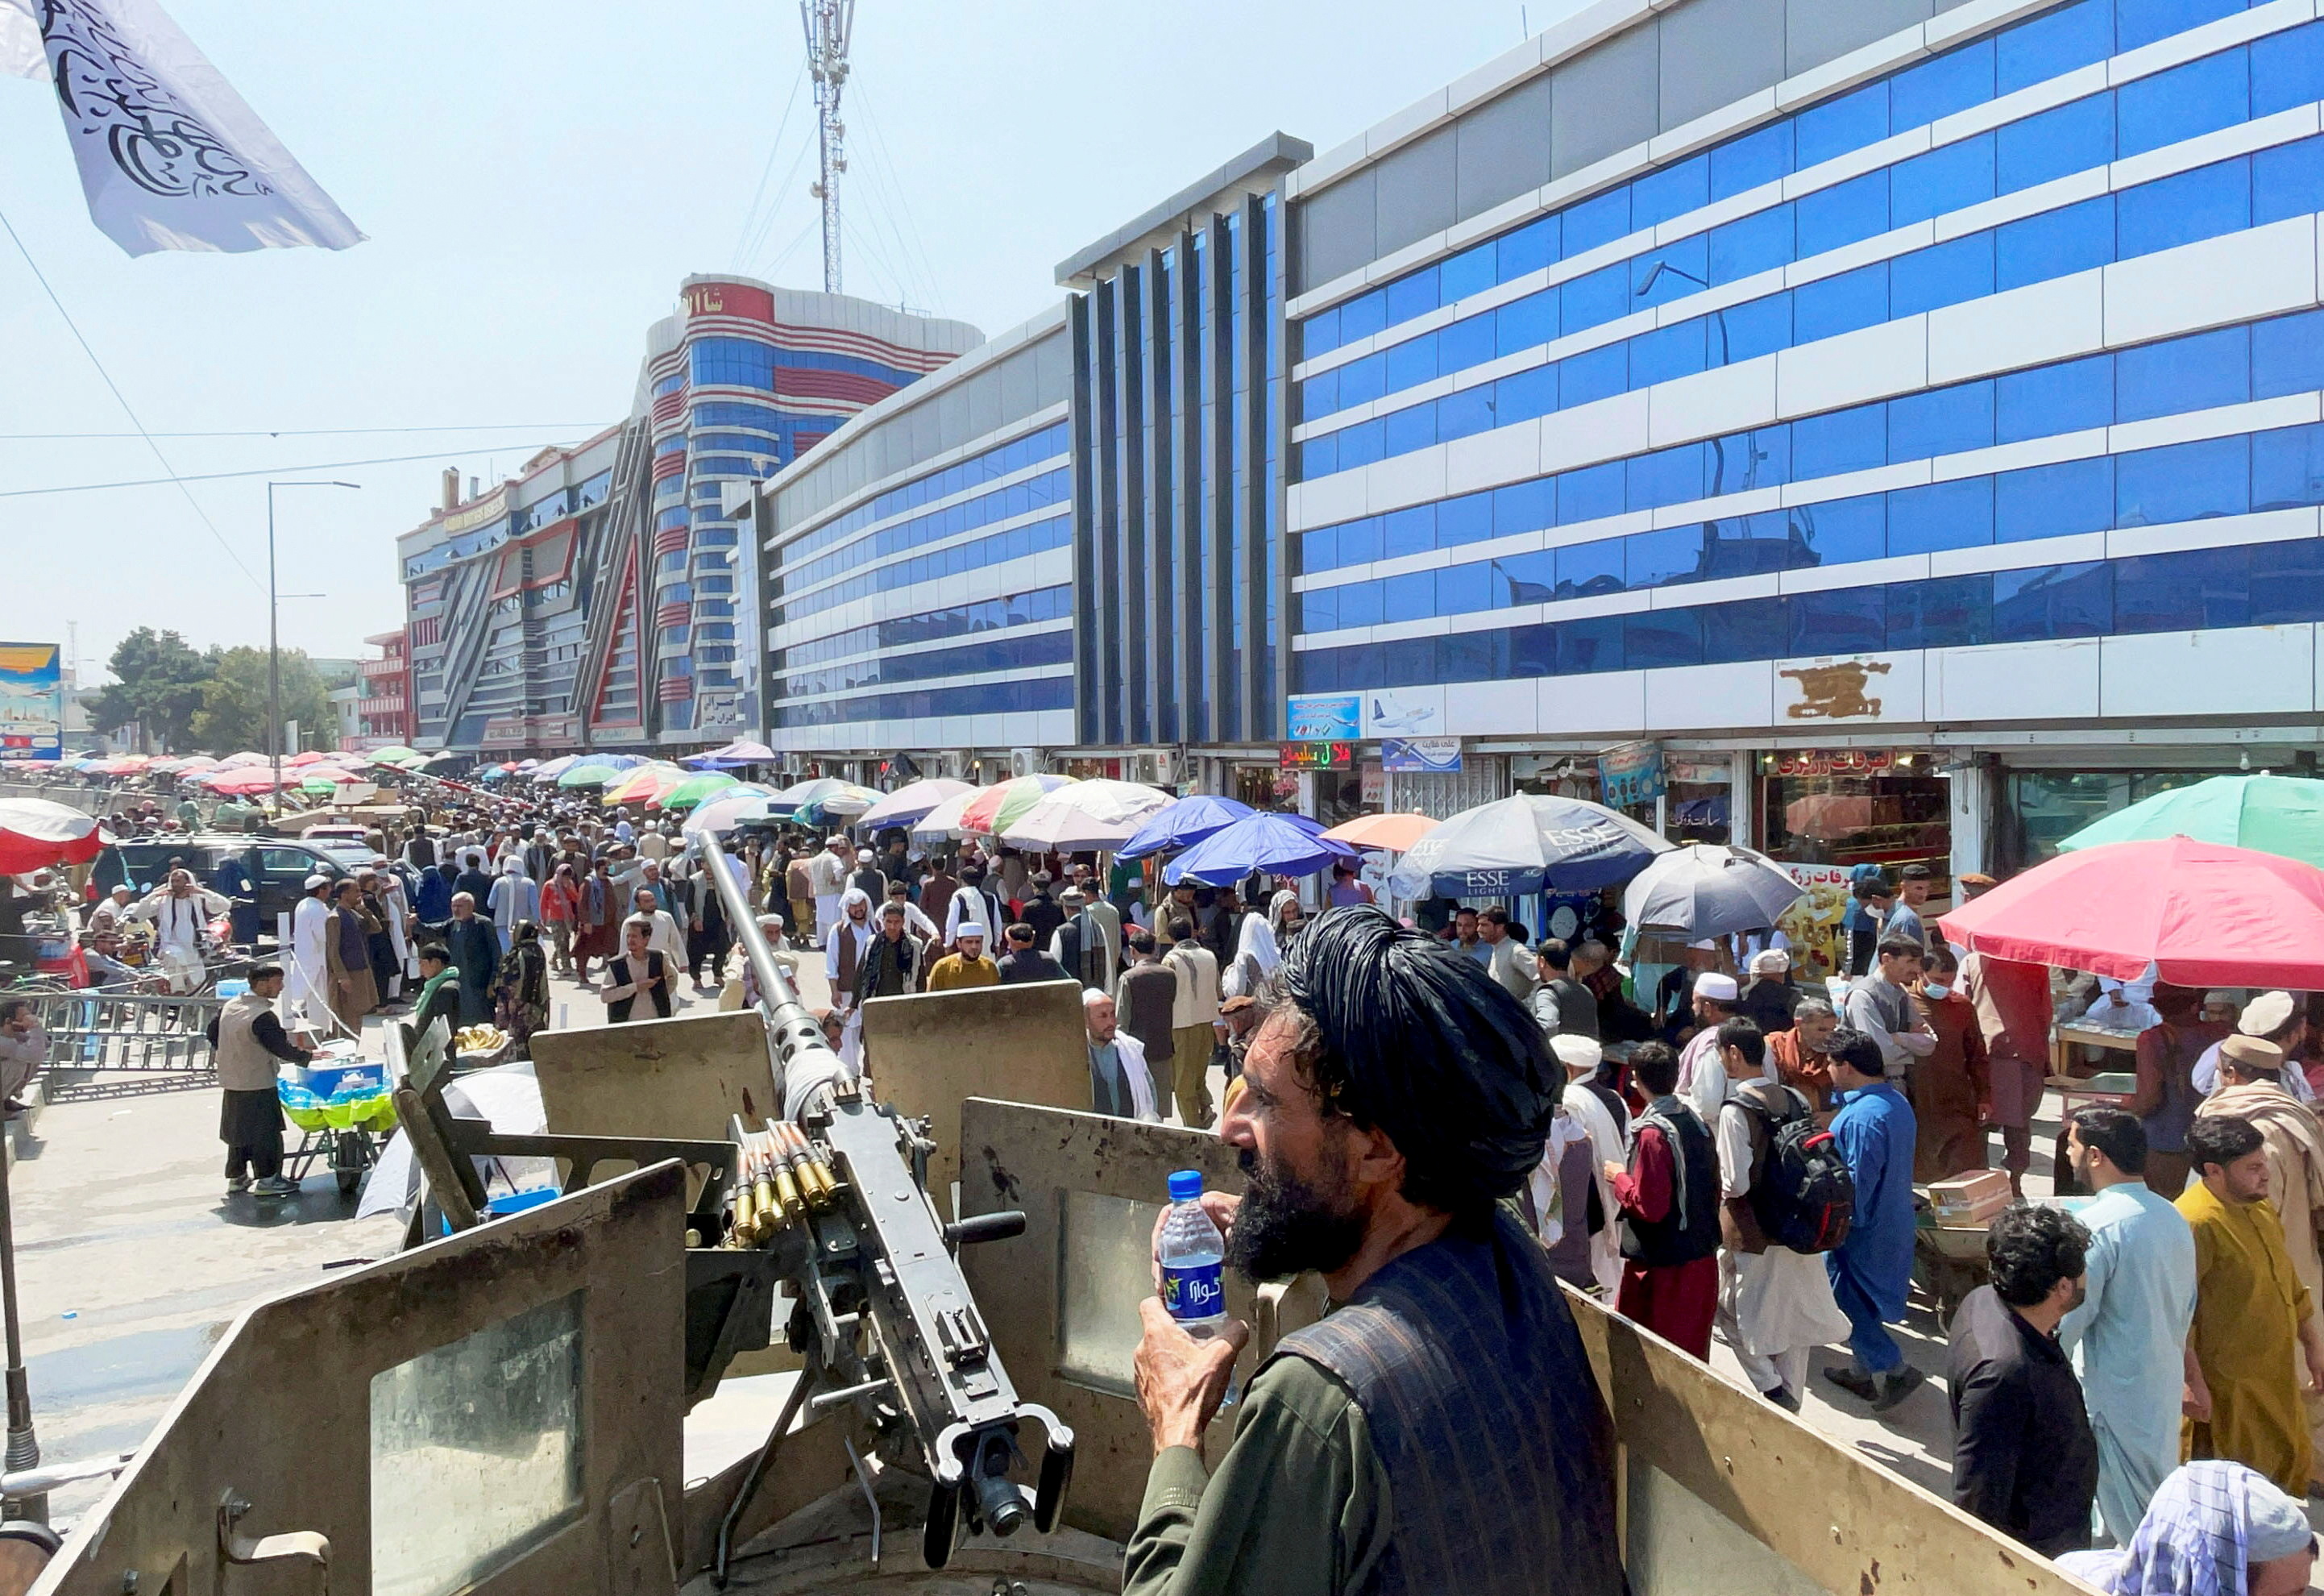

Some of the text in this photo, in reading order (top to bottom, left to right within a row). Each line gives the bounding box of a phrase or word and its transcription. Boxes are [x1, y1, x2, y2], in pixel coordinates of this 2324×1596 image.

[1542, 822, 1625, 847] ESSE
[1466, 870, 1510, 887] ESSE
[1814, 868, 1850, 889] رفات
[1467, 887, 1509, 896] LIGHTS
